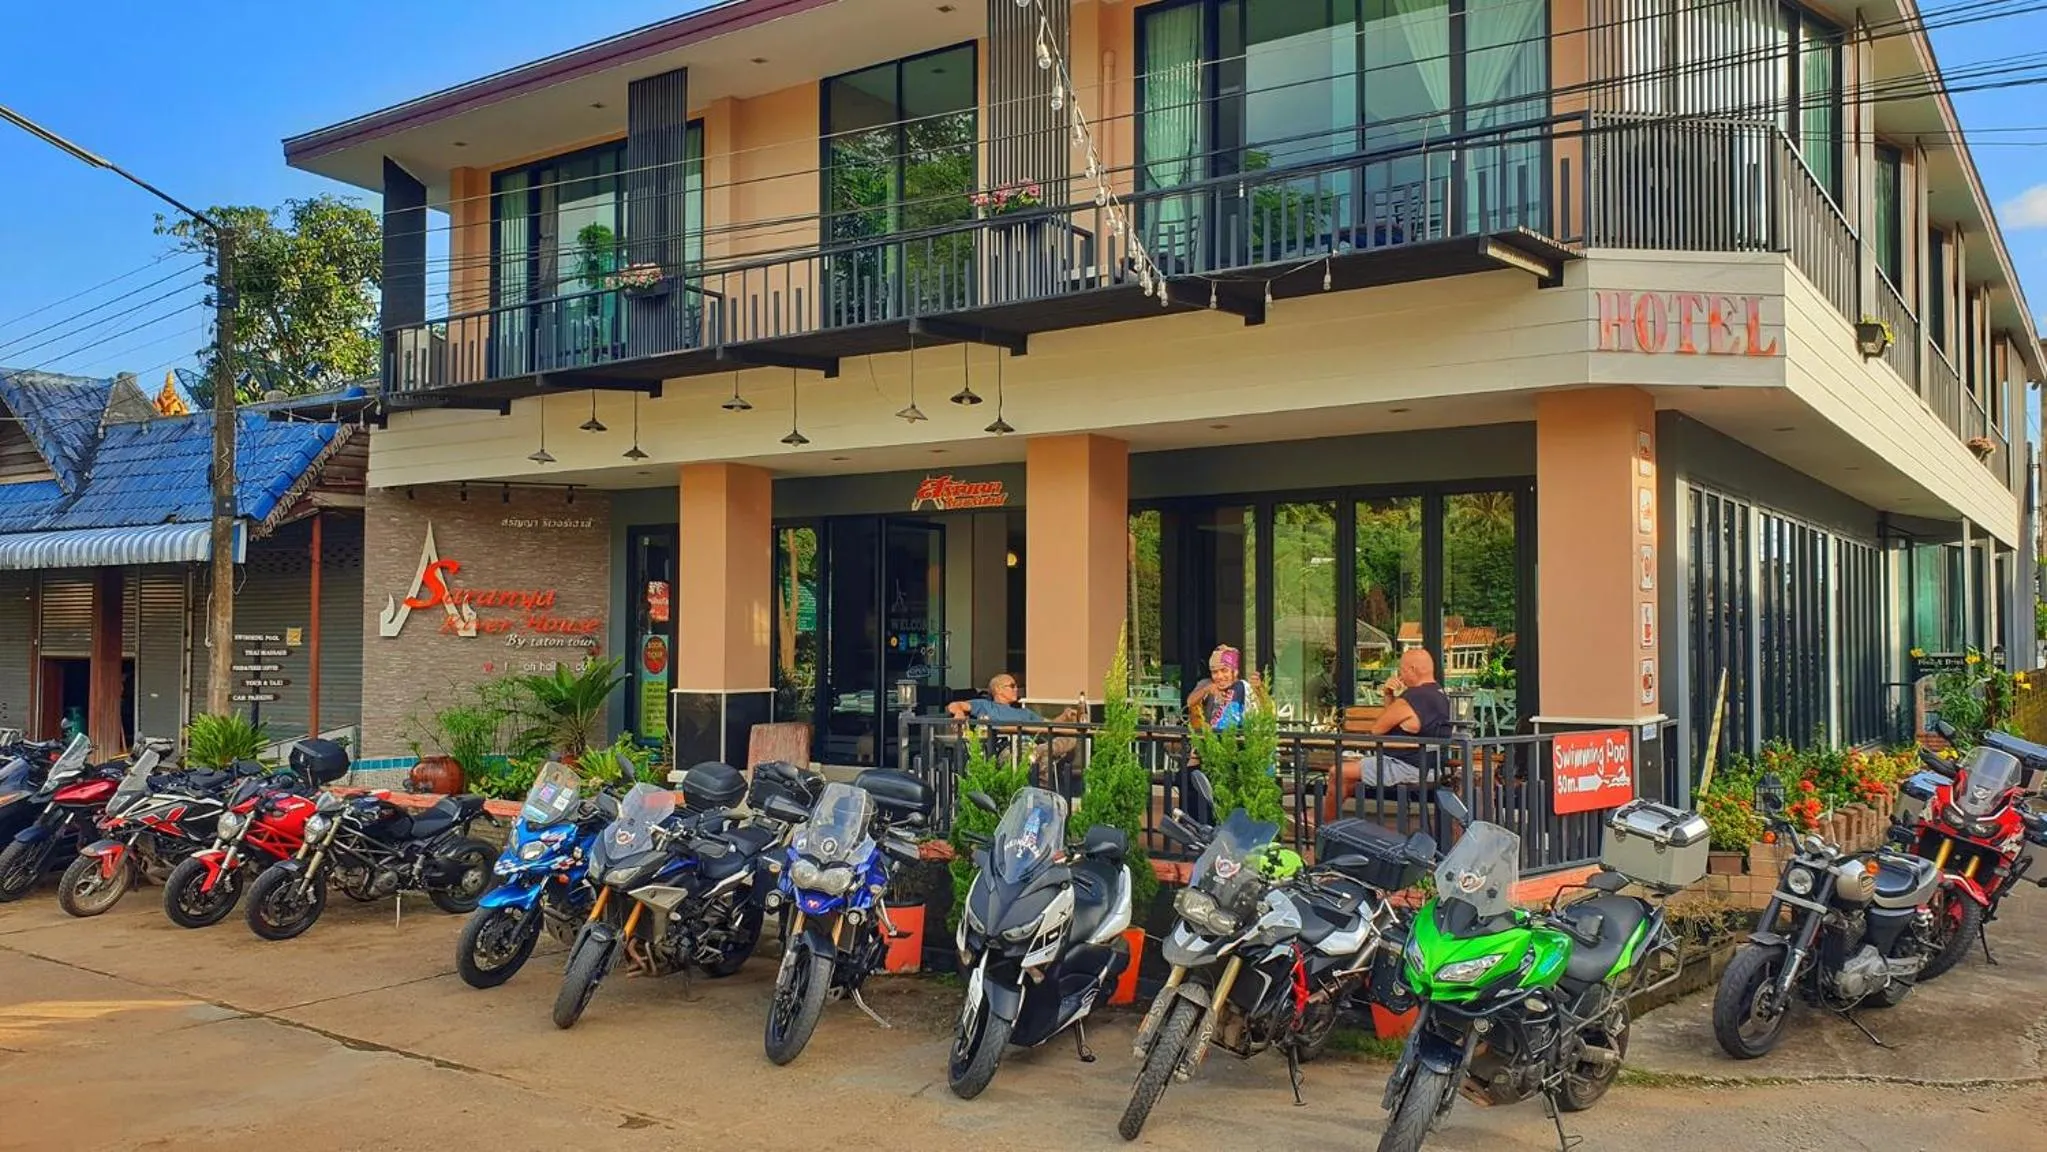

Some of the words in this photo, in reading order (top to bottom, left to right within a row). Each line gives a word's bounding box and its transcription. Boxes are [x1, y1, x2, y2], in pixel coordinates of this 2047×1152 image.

[1595, 291, 1778, 357] HOTEL
[404, 559, 556, 610] Saranya
[505, 633, 526, 648] By
[526, 612, 602, 635] House
[1555, 741, 1604, 775] Swimming
[1606, 737, 1630, 764] Pool
